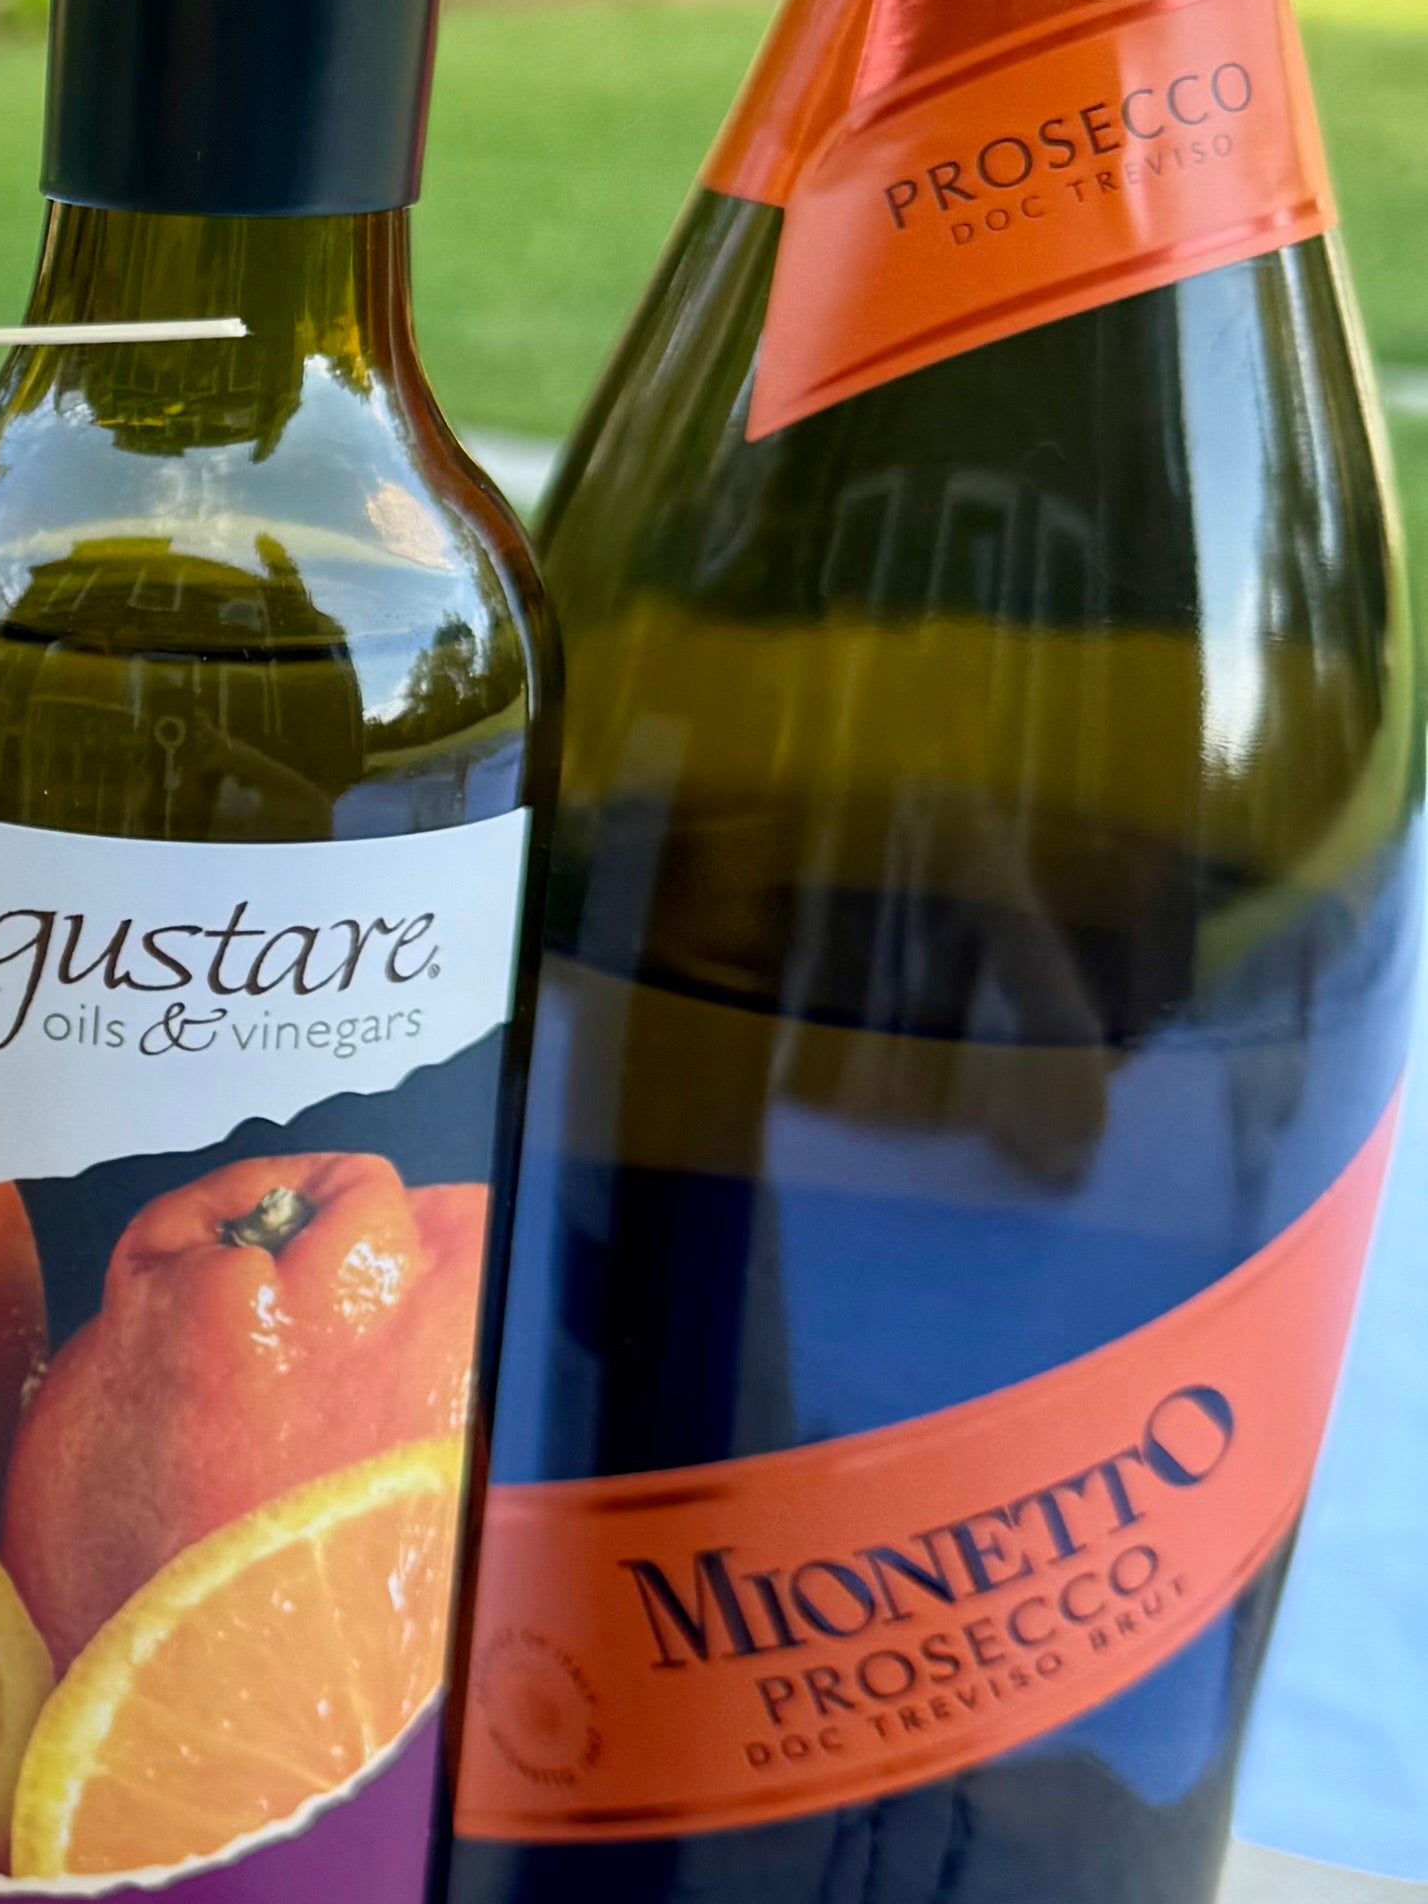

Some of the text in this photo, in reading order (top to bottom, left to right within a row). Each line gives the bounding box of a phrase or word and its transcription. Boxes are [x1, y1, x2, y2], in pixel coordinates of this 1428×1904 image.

[884, 63, 1252, 231] PROSECCO
[951, 134, 1234, 246] DOC TREVISO
[44, 1002, 424, 1059] oils & vinegars
[619, 1384, 1235, 1670] MIONETTO
[745, 1574, 1189, 1769] DOC TREVISO BRUT
[755, 1544, 1160, 1726] PROSECCO
